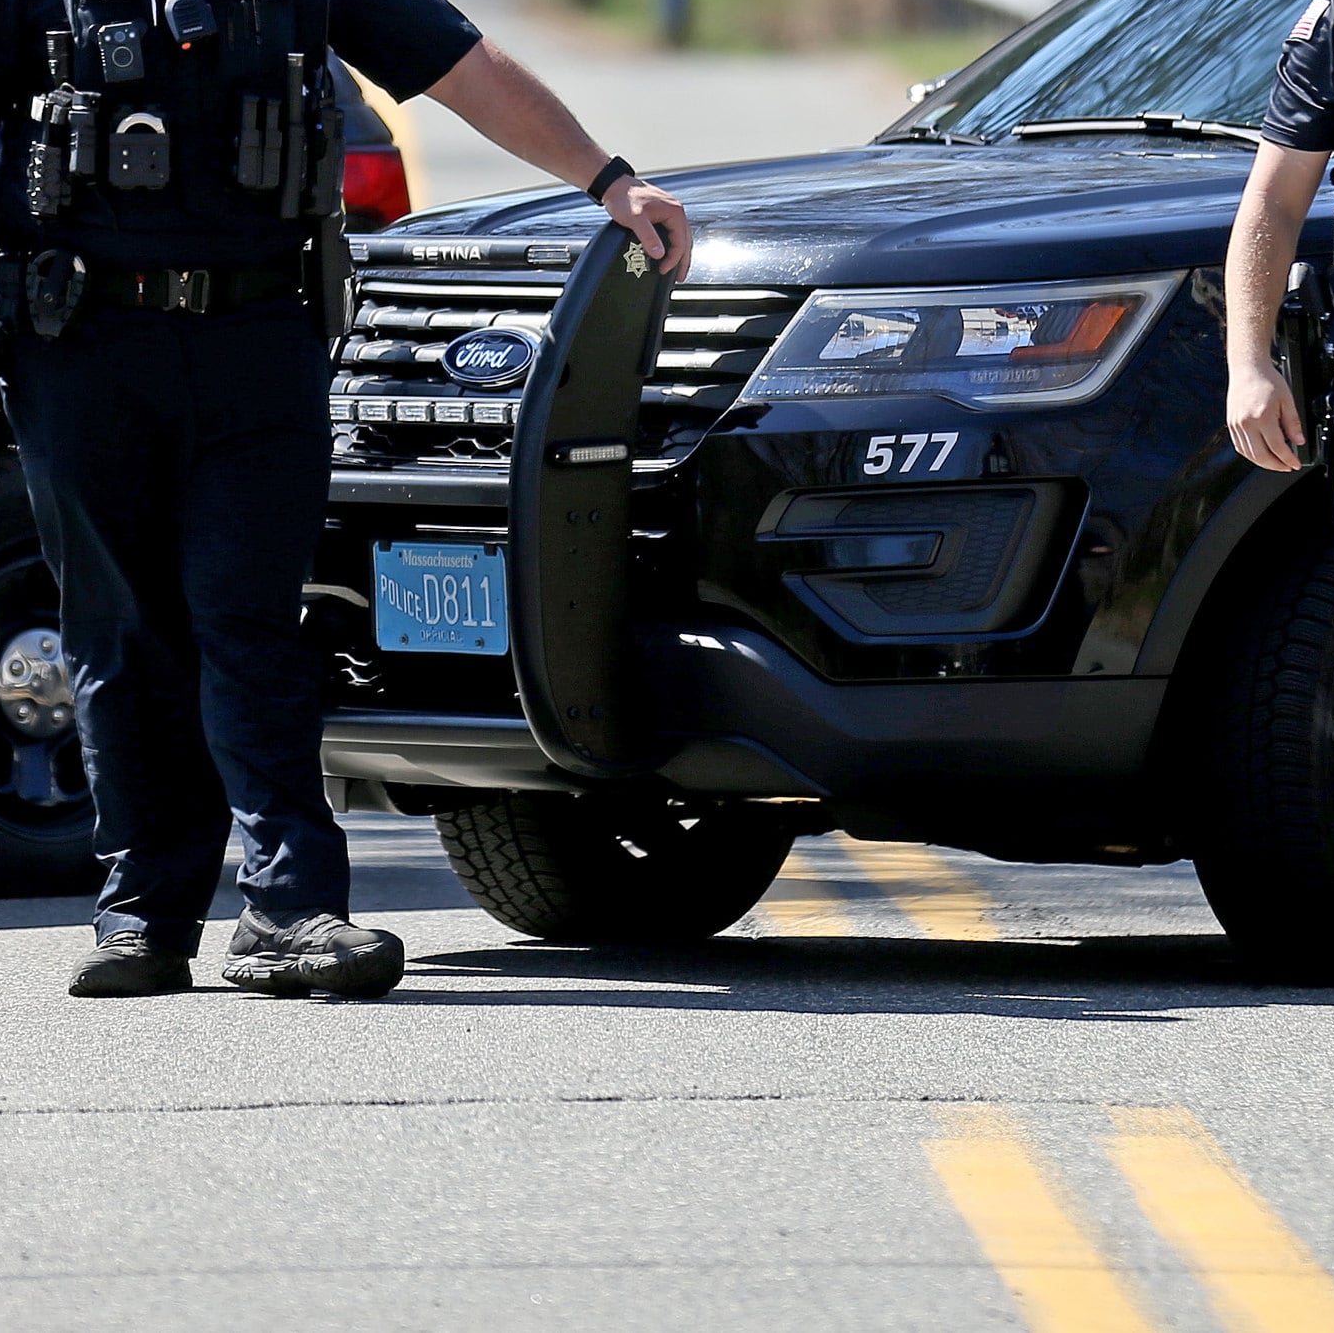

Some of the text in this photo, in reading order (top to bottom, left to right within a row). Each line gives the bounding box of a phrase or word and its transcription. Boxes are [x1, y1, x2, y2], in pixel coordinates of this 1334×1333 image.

[411, 245, 482, 261] SETINA
[455, 341, 514, 369] Ford
[863, 431, 959, 475] 577
[402, 548, 474, 568] Massachusetts
[380, 573, 496, 627] POLICE D811
